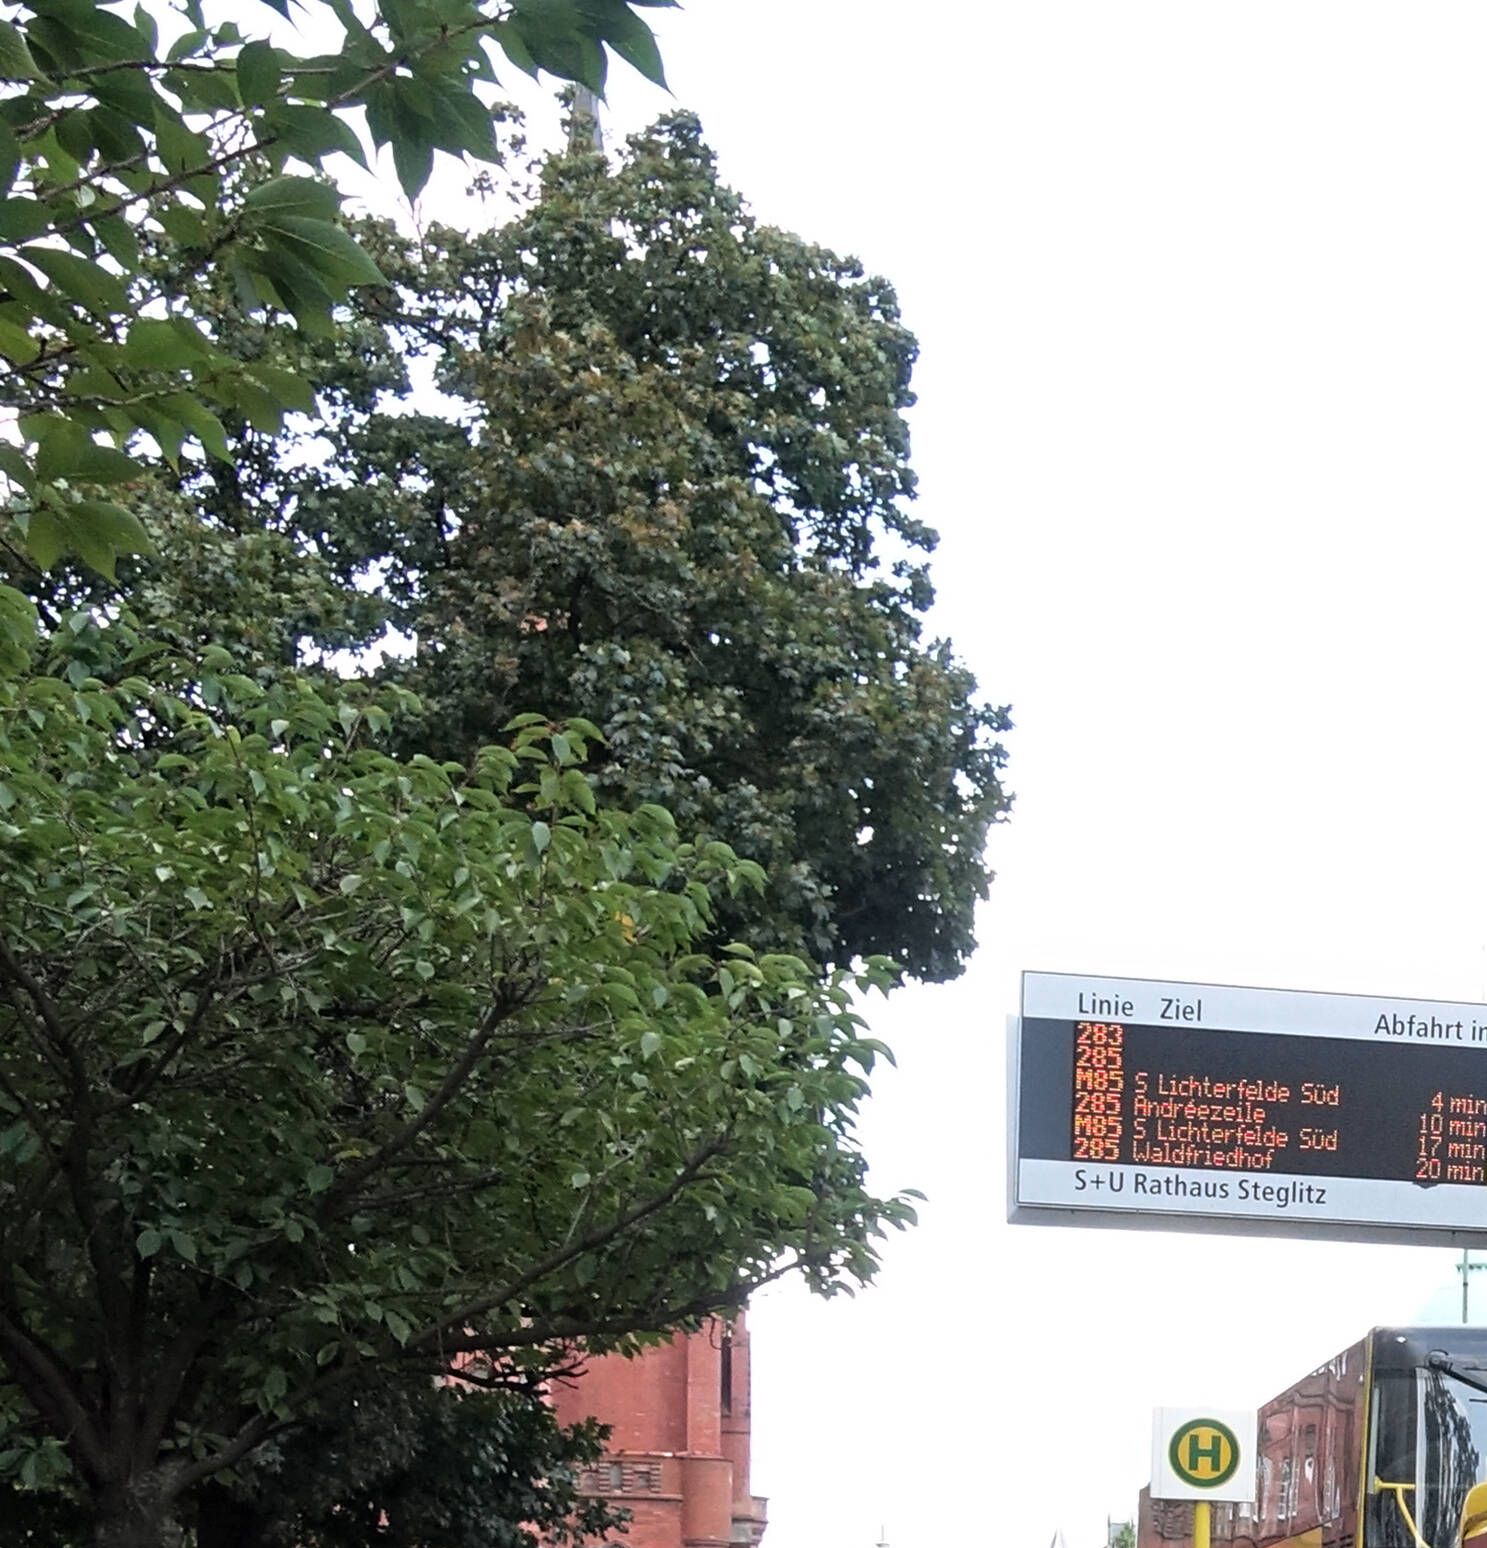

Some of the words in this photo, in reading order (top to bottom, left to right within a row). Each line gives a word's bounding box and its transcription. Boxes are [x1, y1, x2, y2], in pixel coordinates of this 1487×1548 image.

[1077, 1023, 1123, 1045] 283
[1079, 992, 1134, 1016] Linie
[1160, 998, 1202, 1021] Ziel
[1375, 1014, 1463, 1040] Abfahrt
[1077, 1046, 1122, 1069] 285
[1076, 1068, 1124, 1092] M85
[1134, 1072, 1148, 1094] S
[1159, 1073, 1290, 1103] Lichterfelde
[1301, 1083, 1339, 1105] Süd
[1432, 1092, 1443, 1112] 4
[1450, 1094, 1487, 1115] min
[1074, 1114, 1123, 1138] M85
[1134, 1118, 1147, 1141] S
[1157, 1120, 1289, 1148] Lichterfelde
[1299, 1127, 1338, 1151] Süd
[1419, 1136, 1442, 1156] 17
[1448, 1139, 1485, 1159] min
[1075, 1092, 1122, 1115] 285
[1420, 1113, 1443, 1135] 10
[1449, 1116, 1486, 1137] min
[1074, 1138, 1120, 1161] 285
[1133, 1140, 1275, 1169] Waldfriedhof
[1416, 1158, 1441, 1179] 20
[1447, 1161, 1484, 1182] min
[1074, 1169, 1124, 1193] S+U
[1134, 1173, 1229, 1199] Rathaus
[1238, 1178, 1326, 1208] Steglitz
[1188, 1435, 1222, 1472] H
